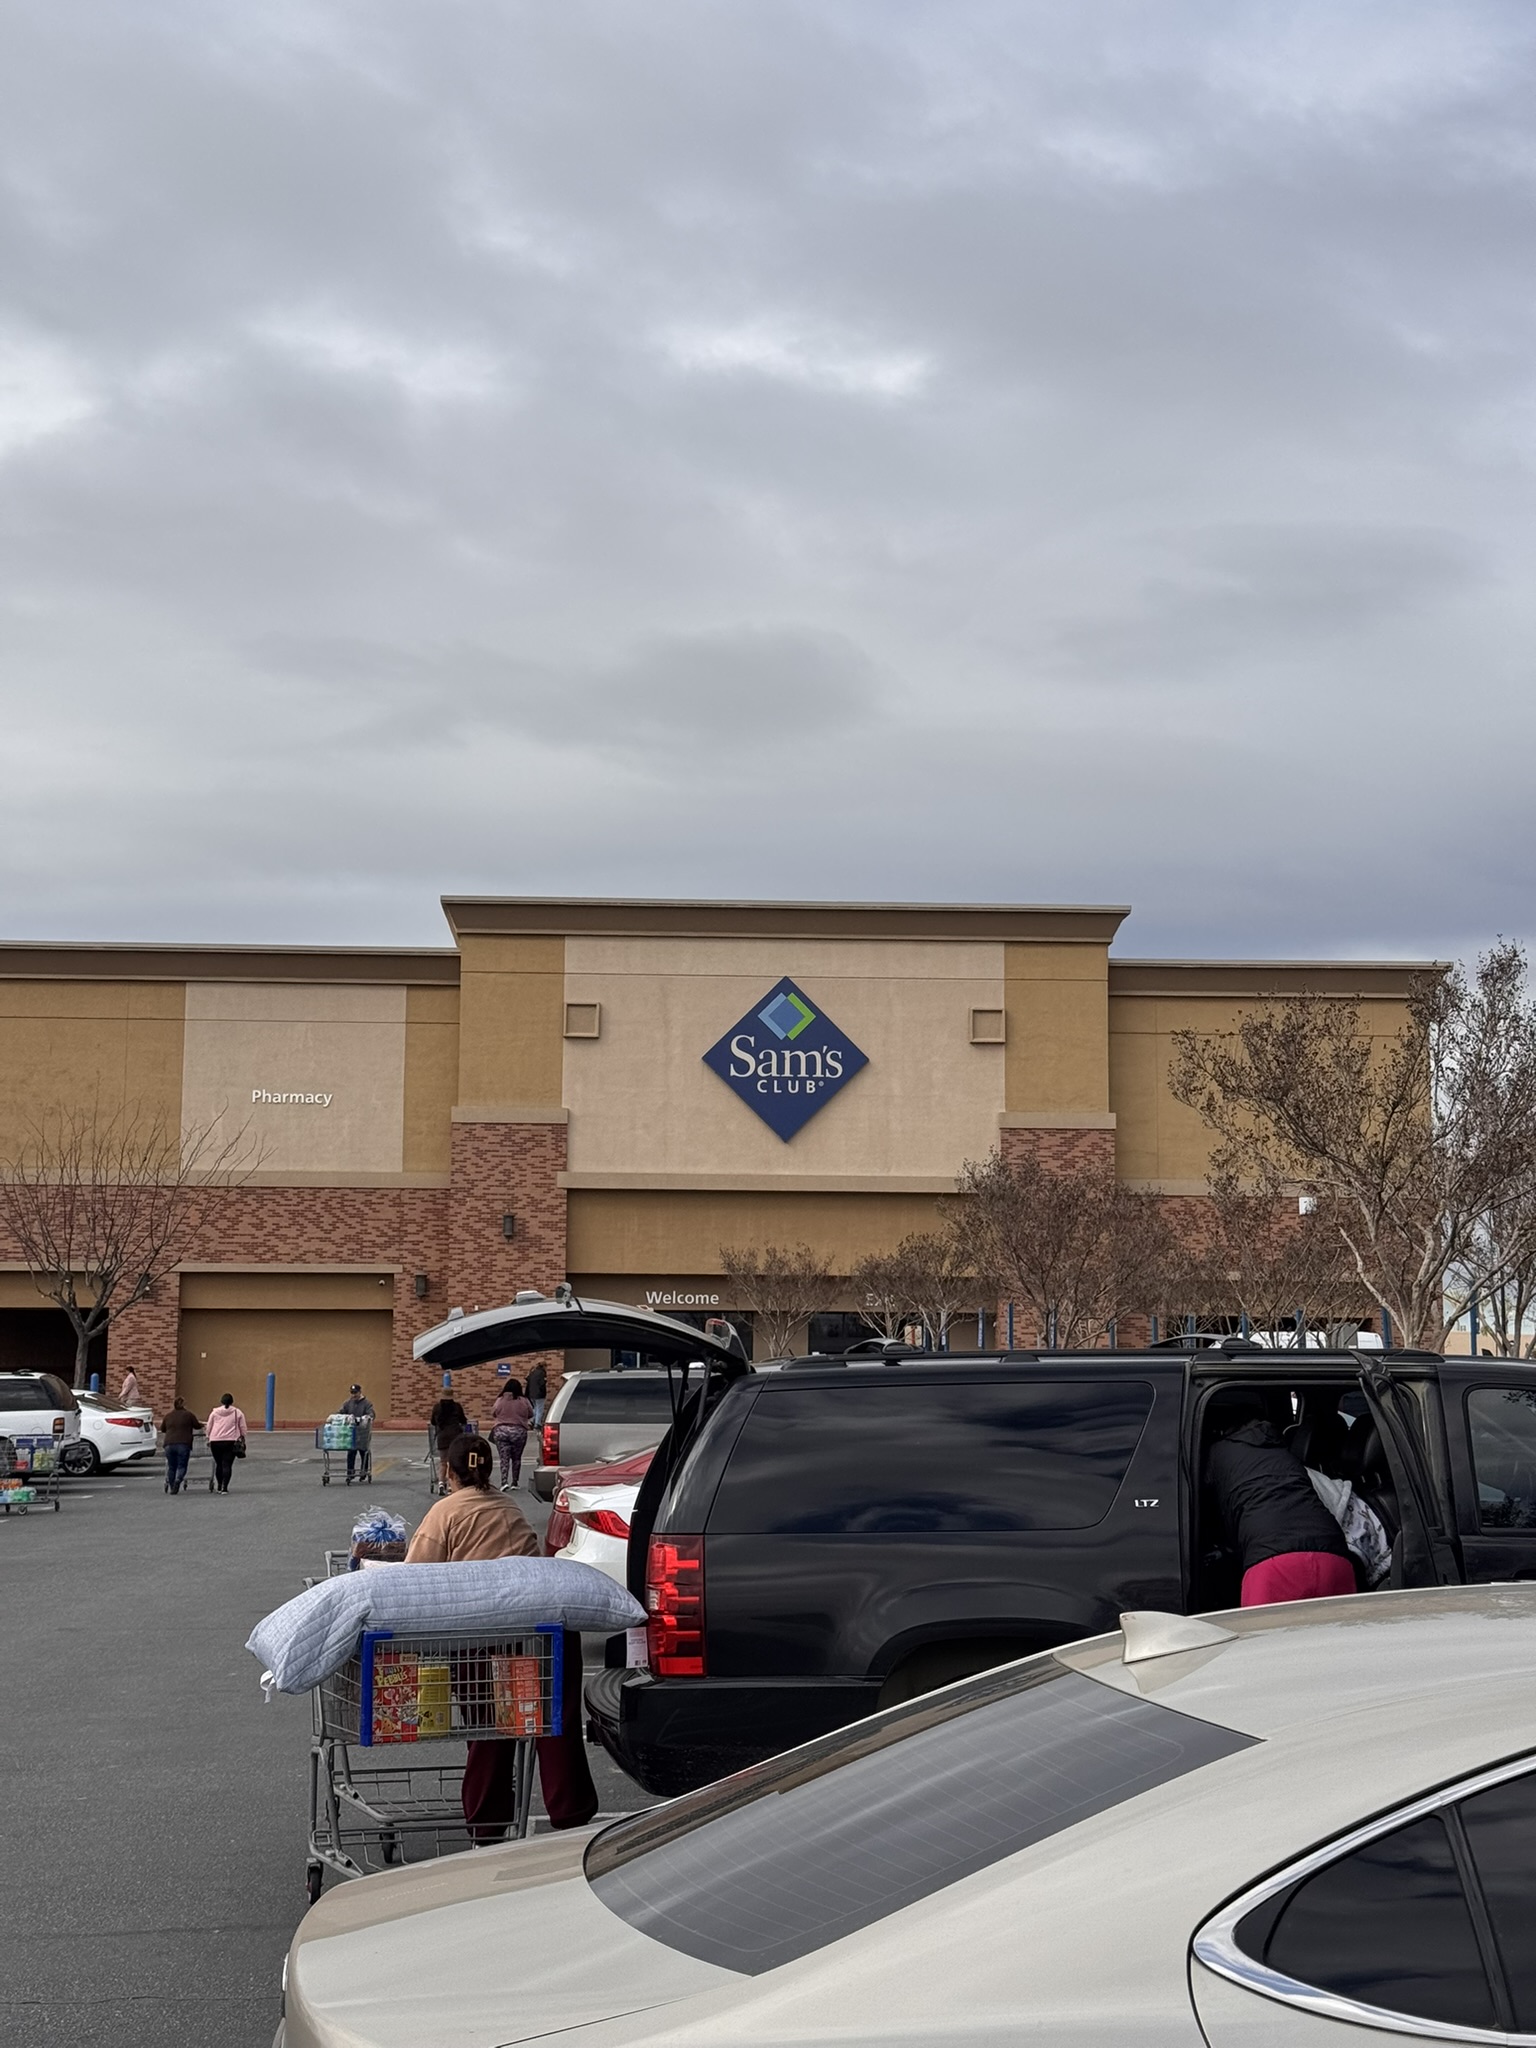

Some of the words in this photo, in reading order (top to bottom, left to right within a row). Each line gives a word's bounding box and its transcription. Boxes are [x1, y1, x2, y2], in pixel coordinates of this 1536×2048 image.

[730, 1034, 843, 1079] Sam's
[251, 1088, 333, 1108] Pharmacy
[645, 1290, 720, 1305] Welcome
[1134, 1498, 1160, 1508] LTZ
